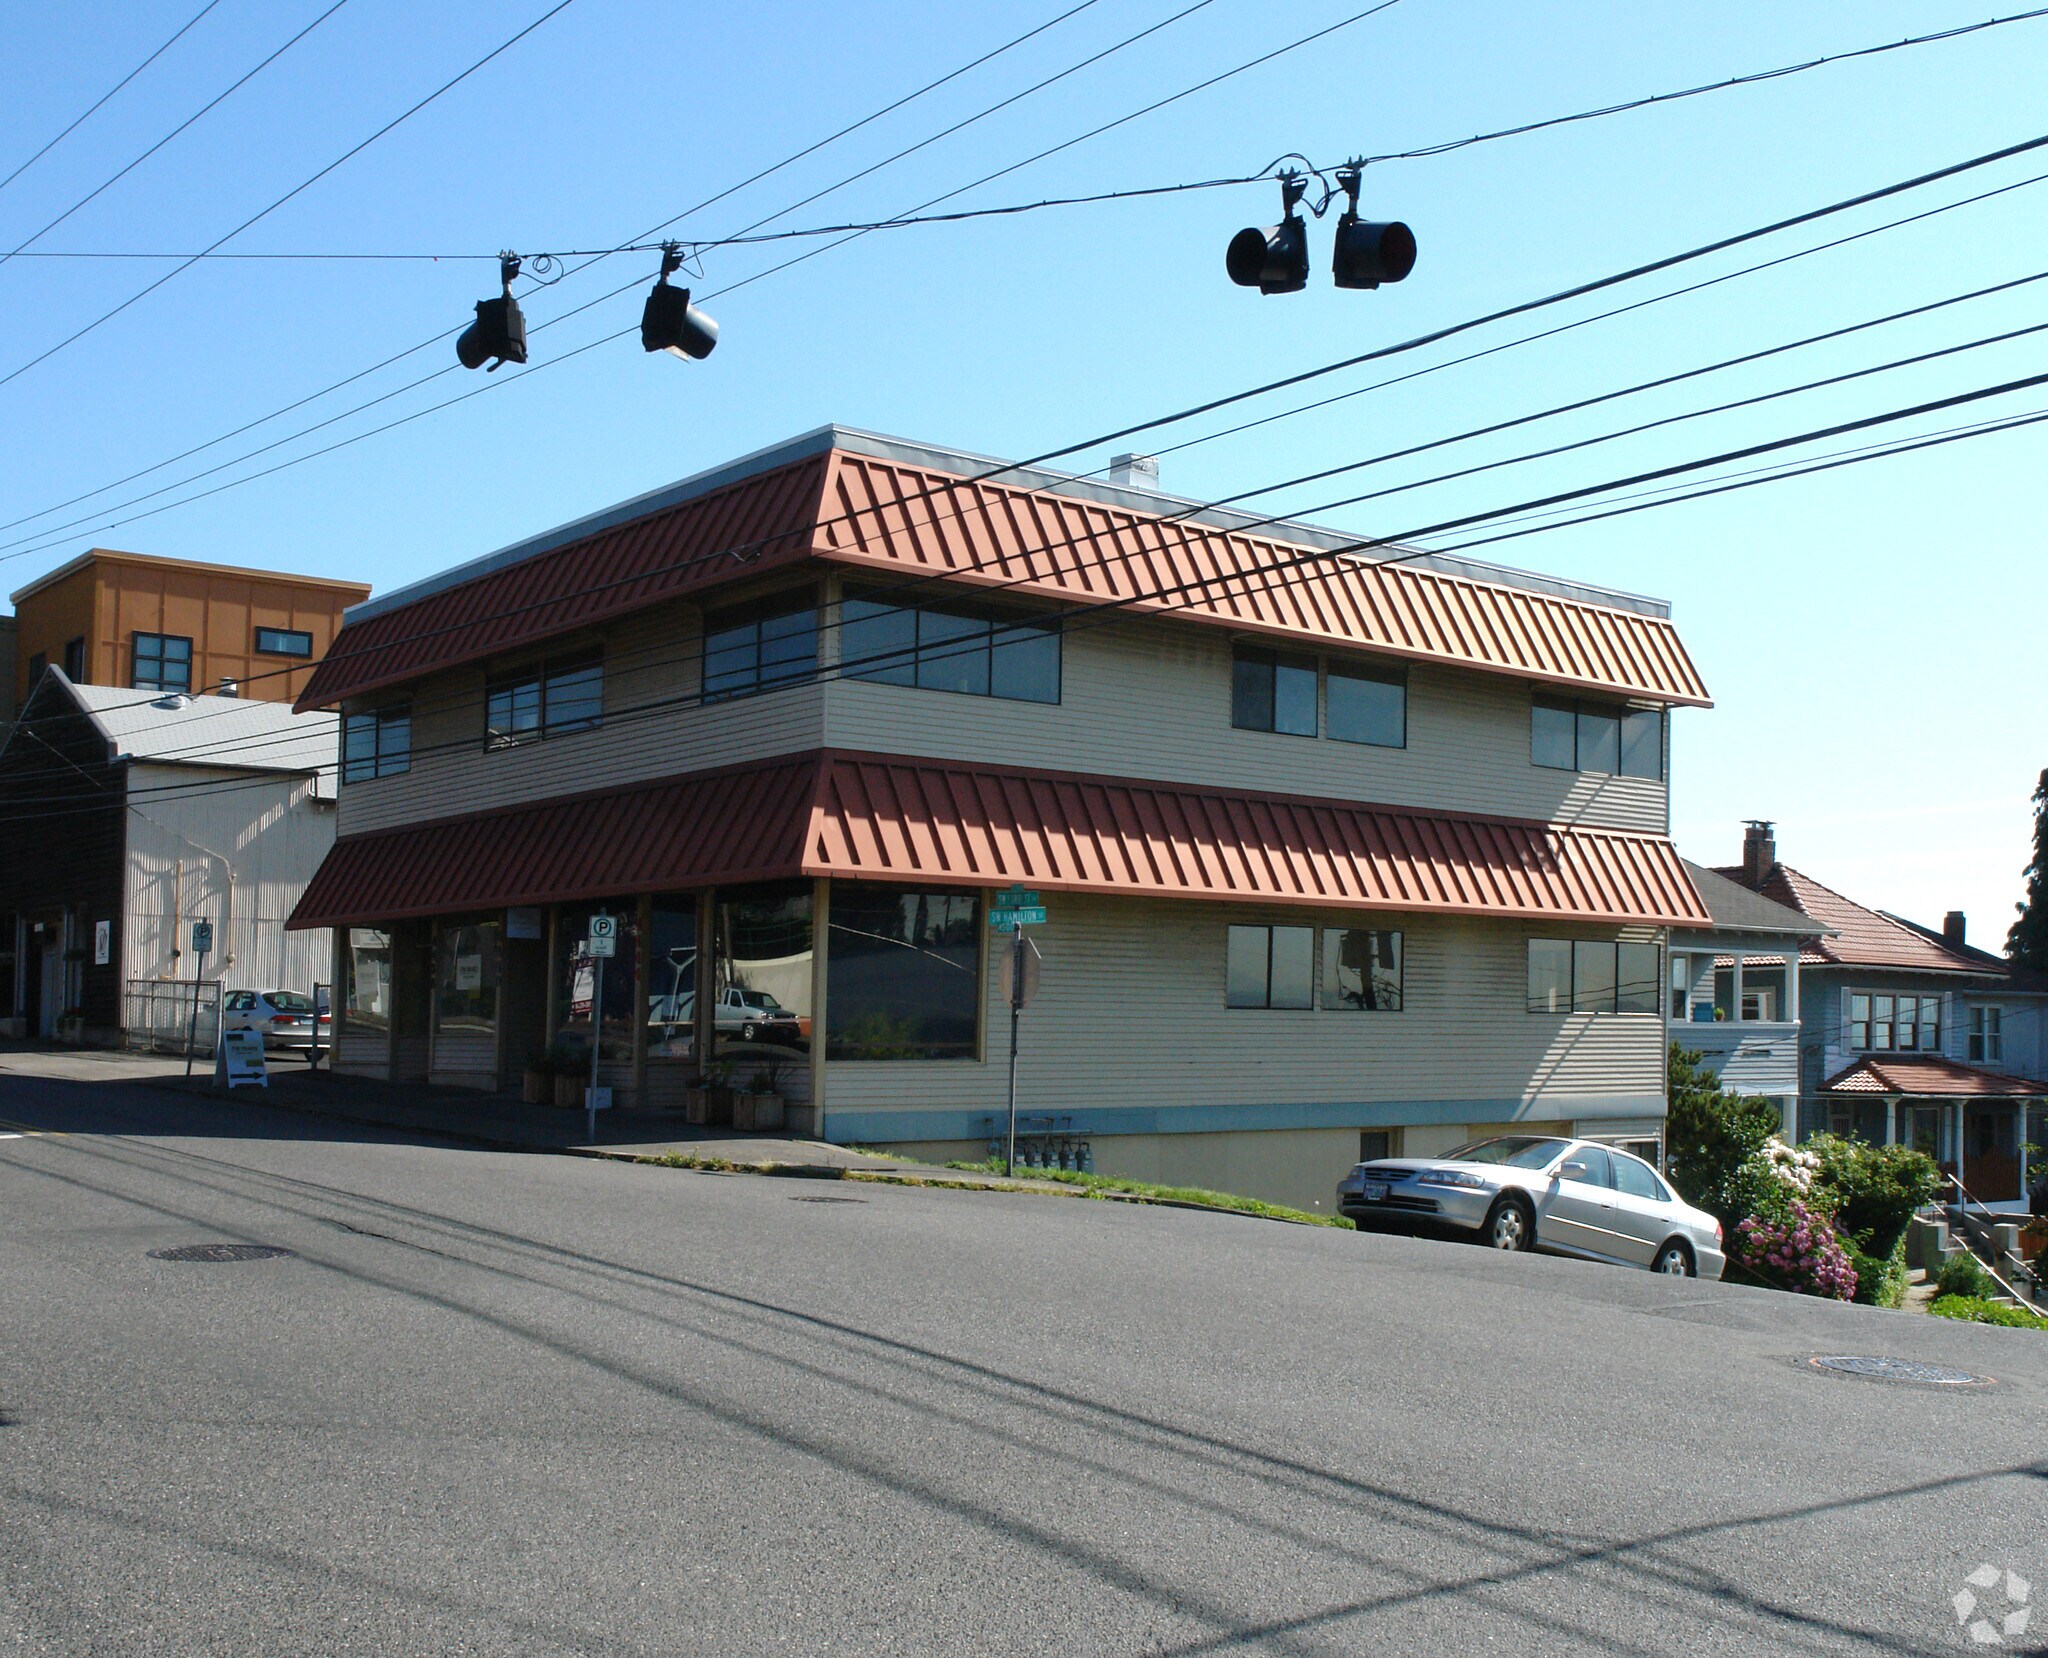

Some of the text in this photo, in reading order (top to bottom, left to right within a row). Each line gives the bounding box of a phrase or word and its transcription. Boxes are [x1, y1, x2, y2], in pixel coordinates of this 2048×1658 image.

[991, 911, 1001, 922] SW
[1003, 910, 1037, 922] HAMILTON
[200, 927, 207, 936] P
[599, 921, 608, 932] P
